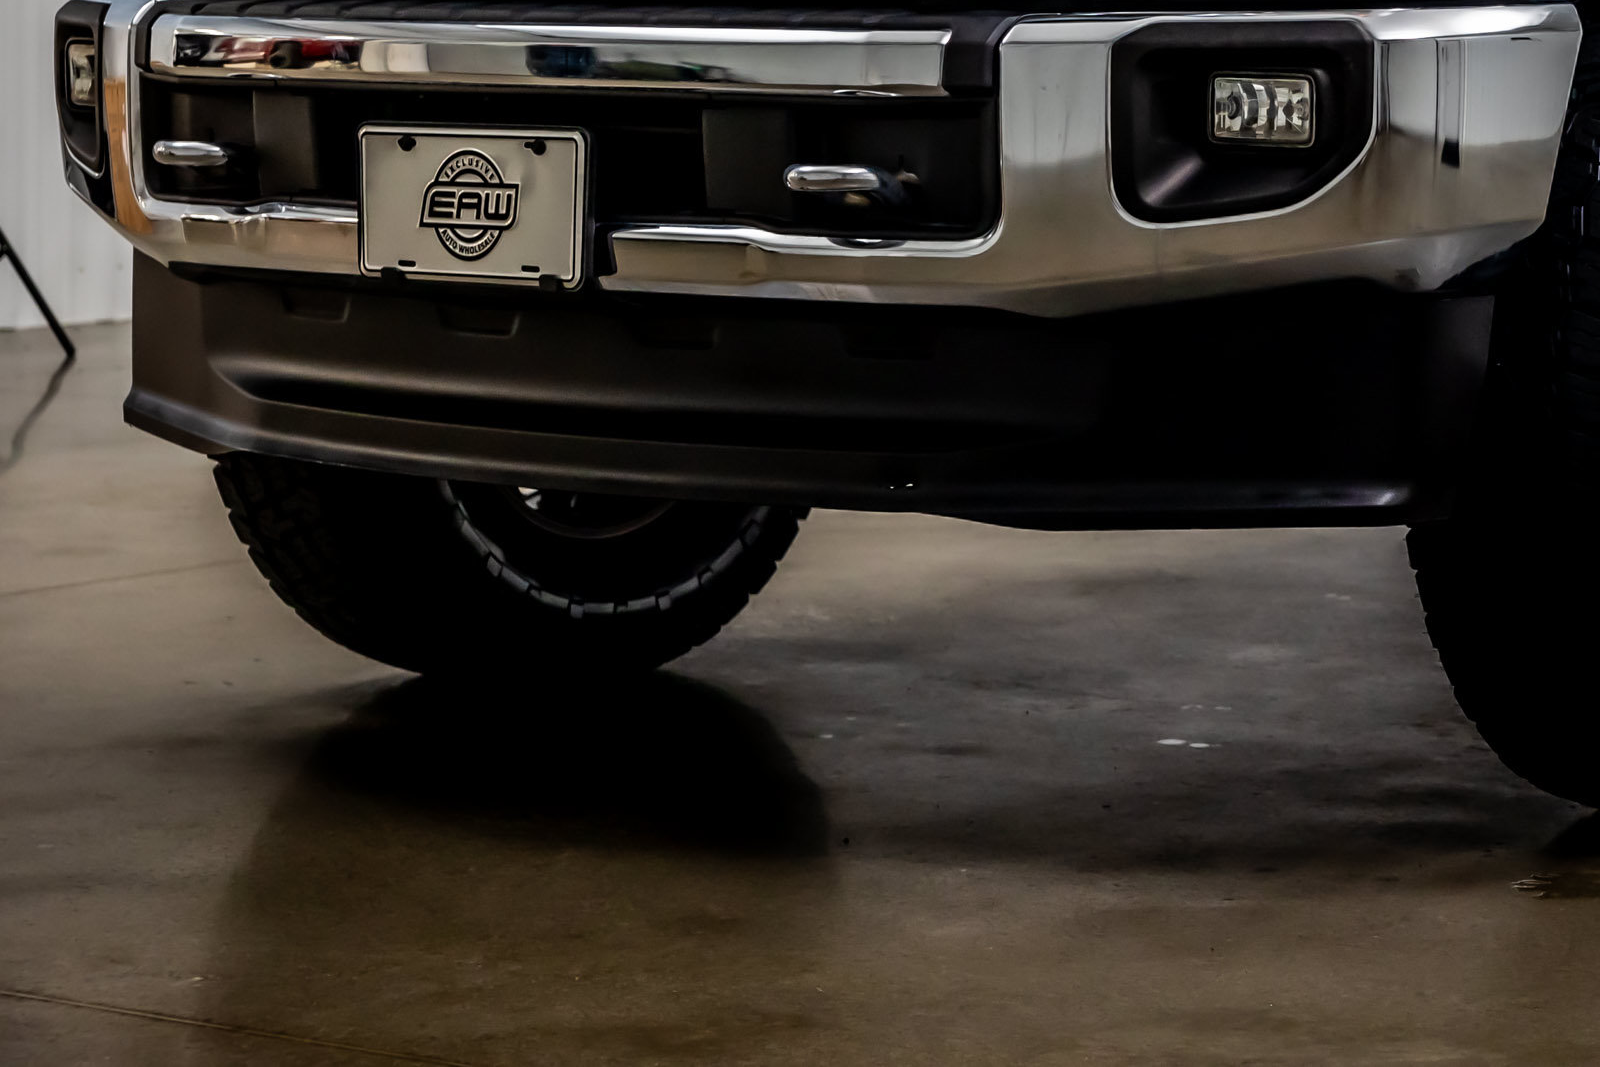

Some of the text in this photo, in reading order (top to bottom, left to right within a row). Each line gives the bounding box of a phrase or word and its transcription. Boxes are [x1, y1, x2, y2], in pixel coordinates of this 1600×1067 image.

[444, 157, 496, 182] EXCLUSIVE
[427, 189, 512, 221] EAW
[440, 228, 496, 255] AUTO WHOLESALE
